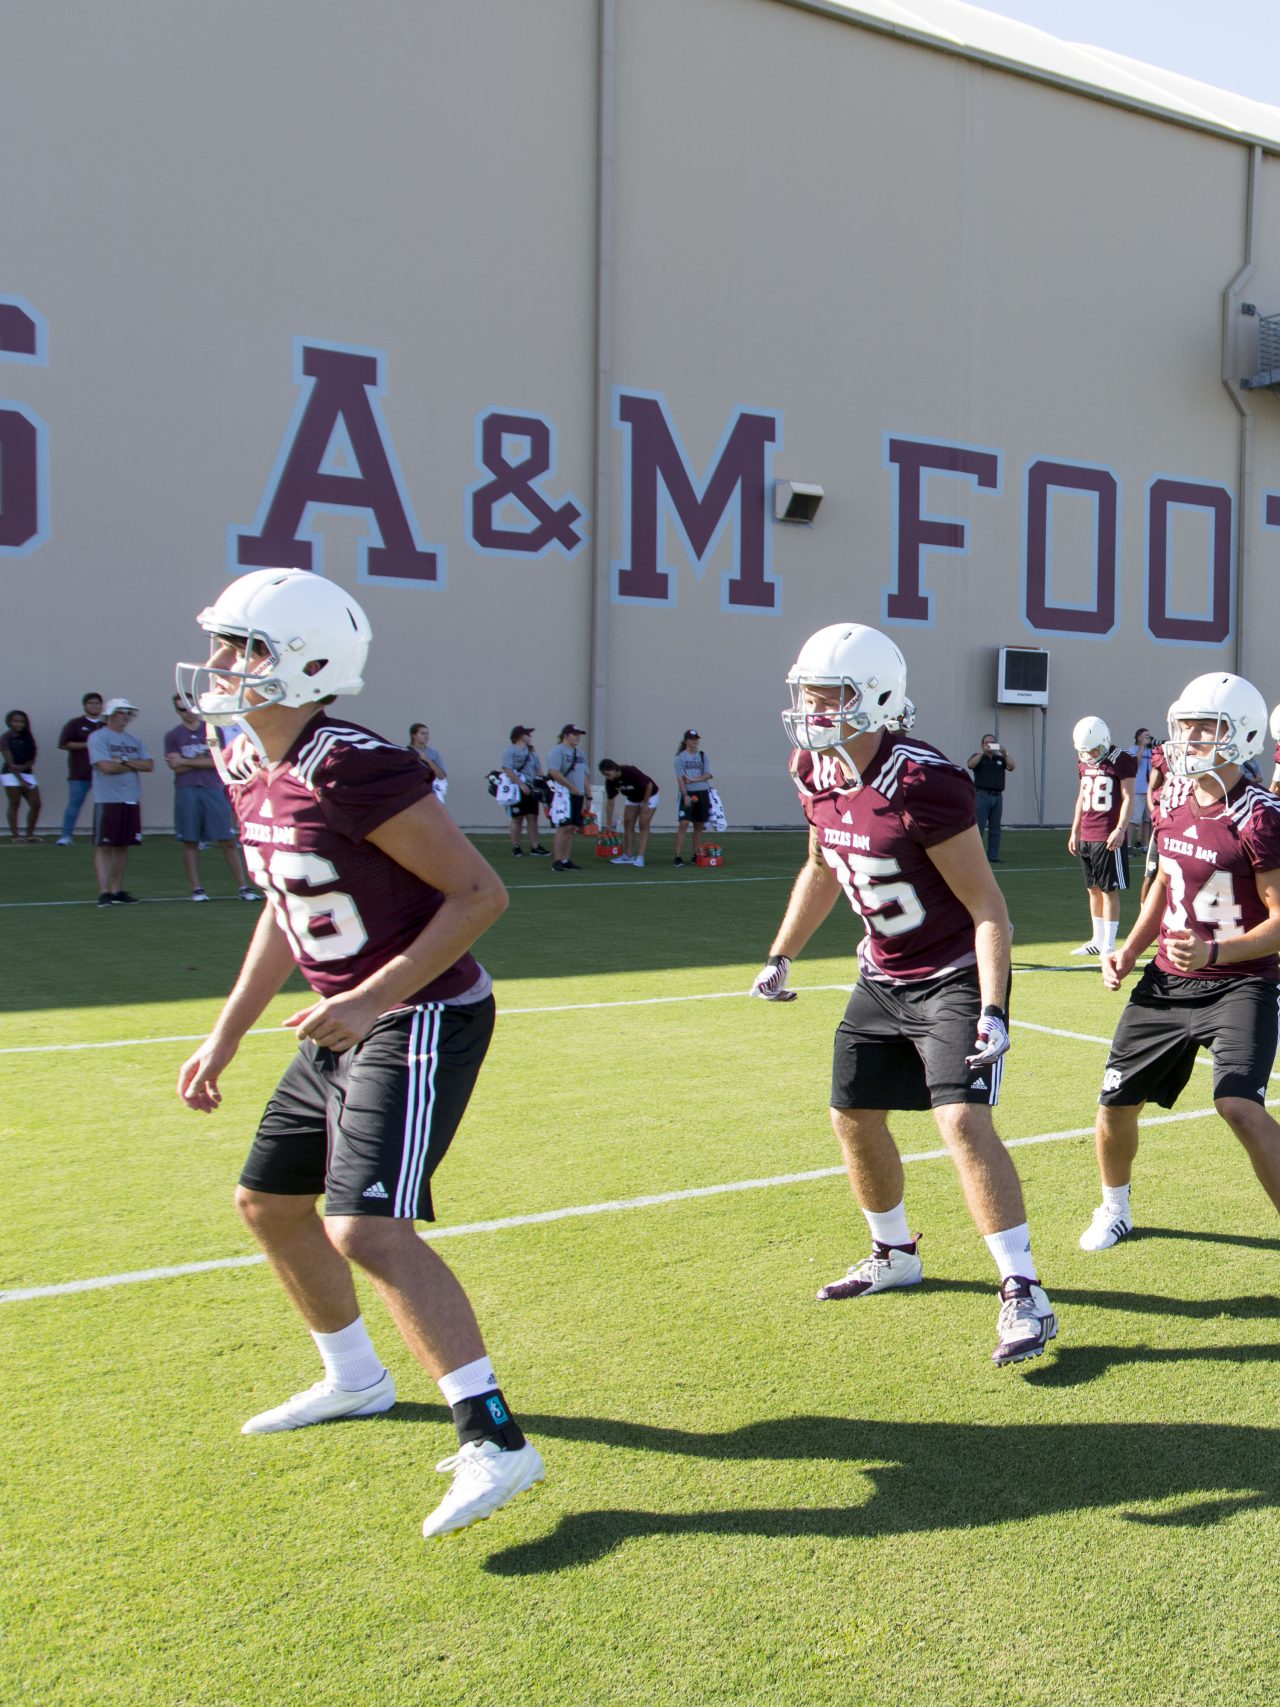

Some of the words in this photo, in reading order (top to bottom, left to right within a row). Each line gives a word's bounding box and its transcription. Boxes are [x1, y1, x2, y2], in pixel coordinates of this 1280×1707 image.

[243, 821, 271, 843] TEXAS
[824, 828, 851, 847] TEXAS
[1163, 837, 1193, 857] TEXAS
[709, 858, 717, 866] G
[362, 1190, 389, 1199] adidas
